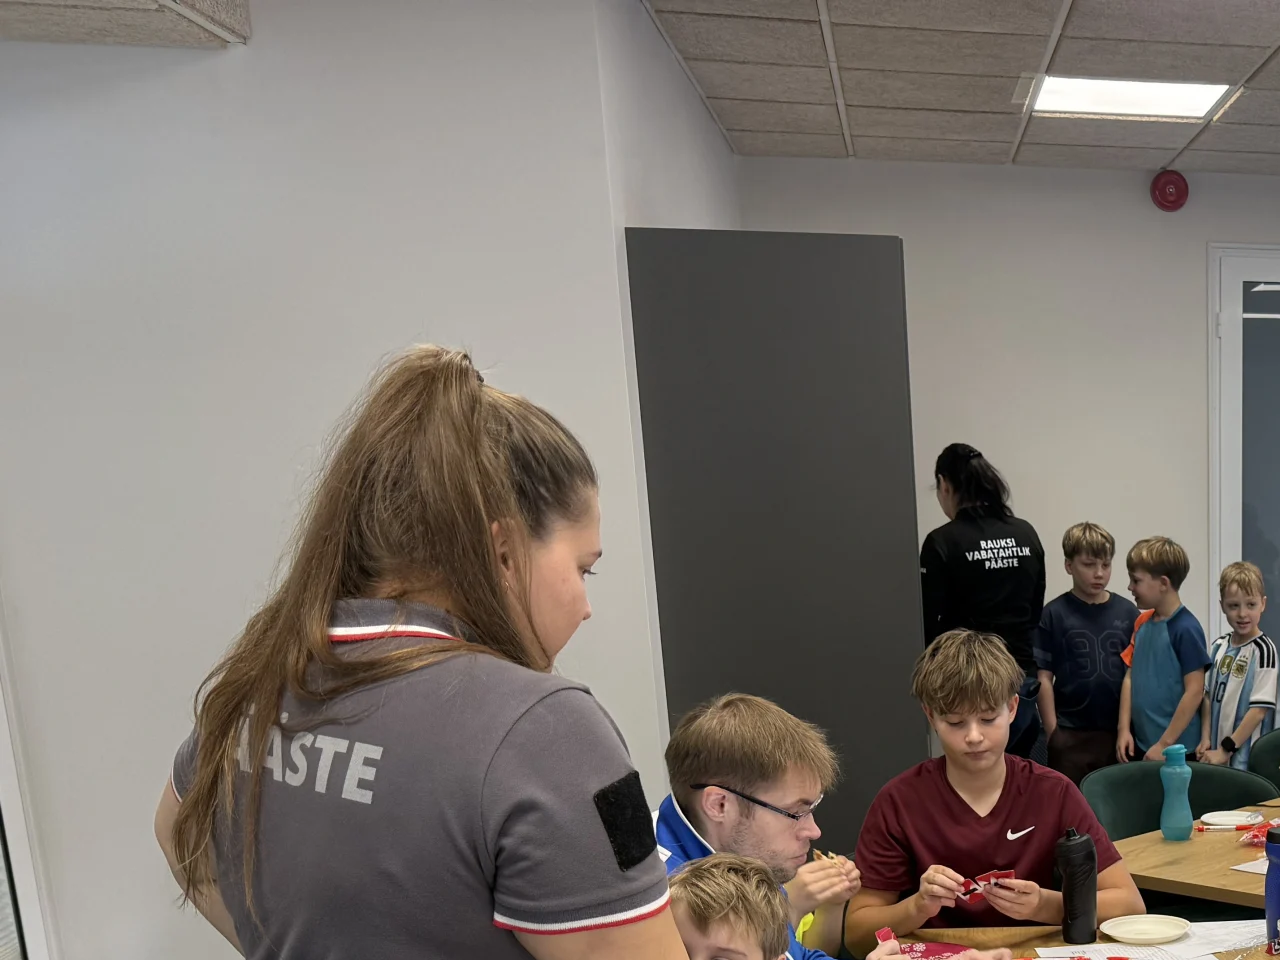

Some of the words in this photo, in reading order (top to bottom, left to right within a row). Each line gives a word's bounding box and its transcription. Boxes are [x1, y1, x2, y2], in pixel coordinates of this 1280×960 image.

[980, 538, 1016, 549] RAUKSI
[965, 547, 1031, 561] VABATAHTLIK
[985, 558, 1019, 569] PÄÄSTE
